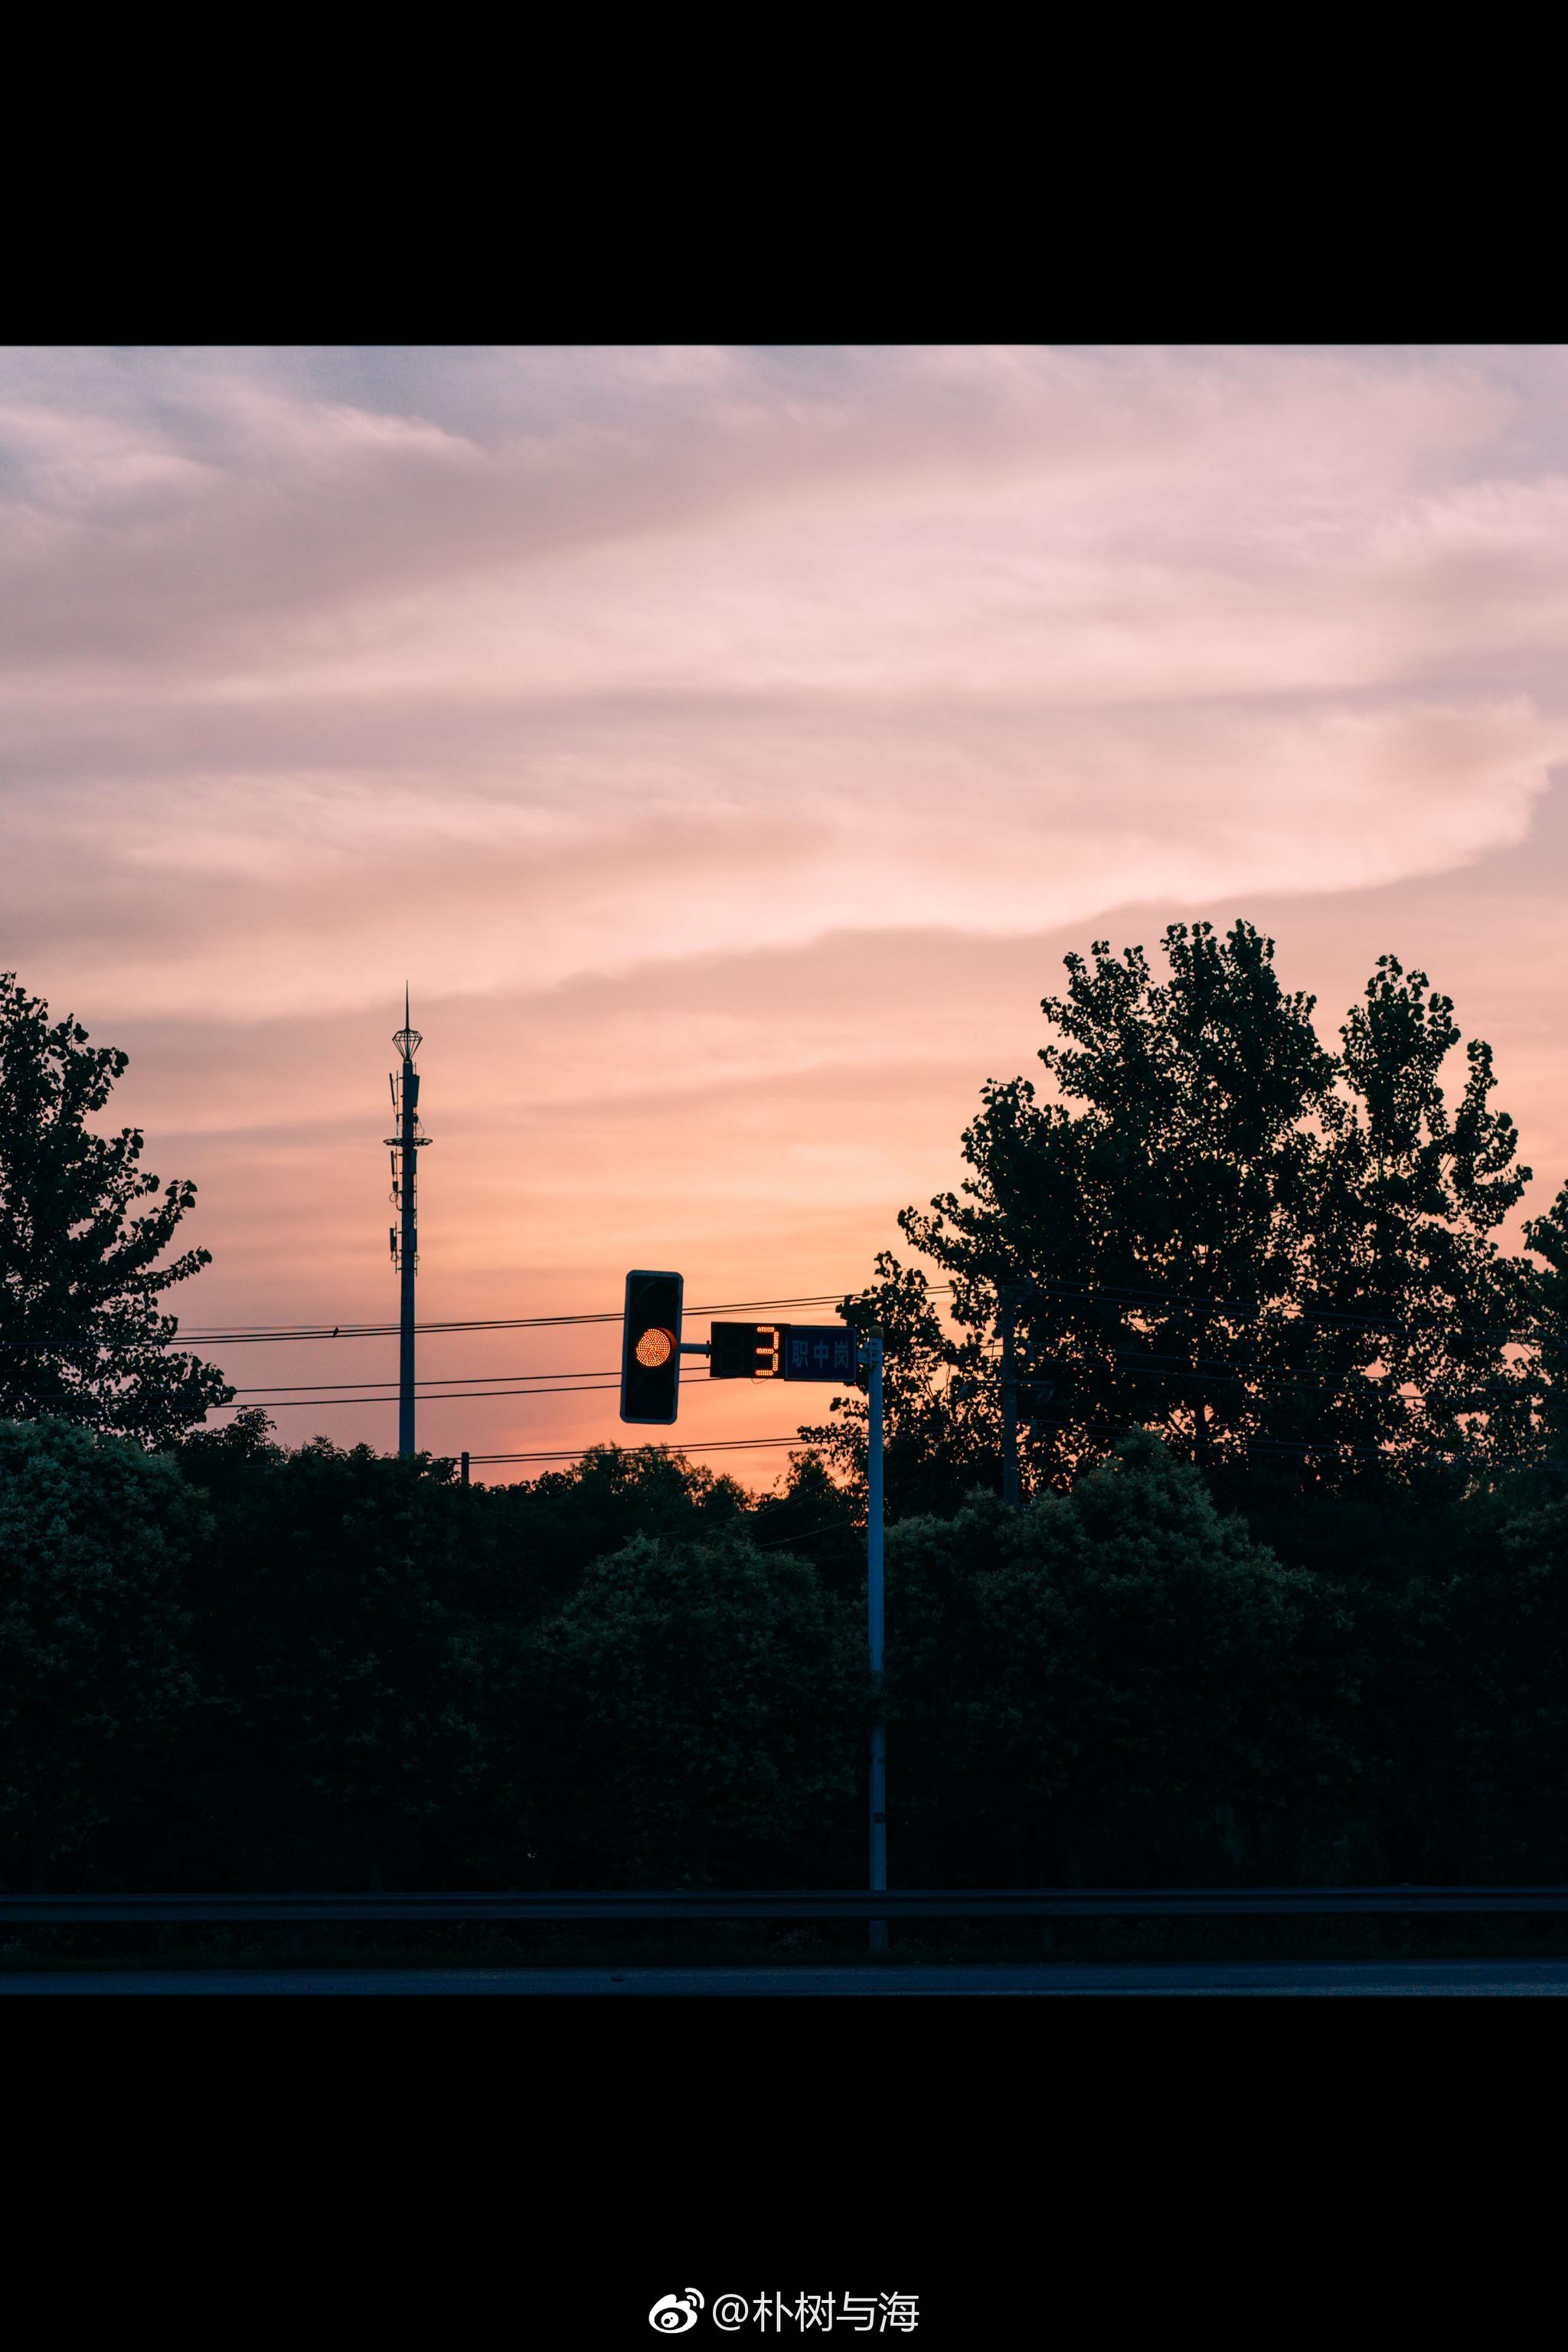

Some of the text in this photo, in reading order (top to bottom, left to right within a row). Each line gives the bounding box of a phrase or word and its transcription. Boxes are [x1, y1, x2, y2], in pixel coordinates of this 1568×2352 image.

[755, 1325, 779, 1377] 3
[792, 1339, 850, 1369] 职中岗
